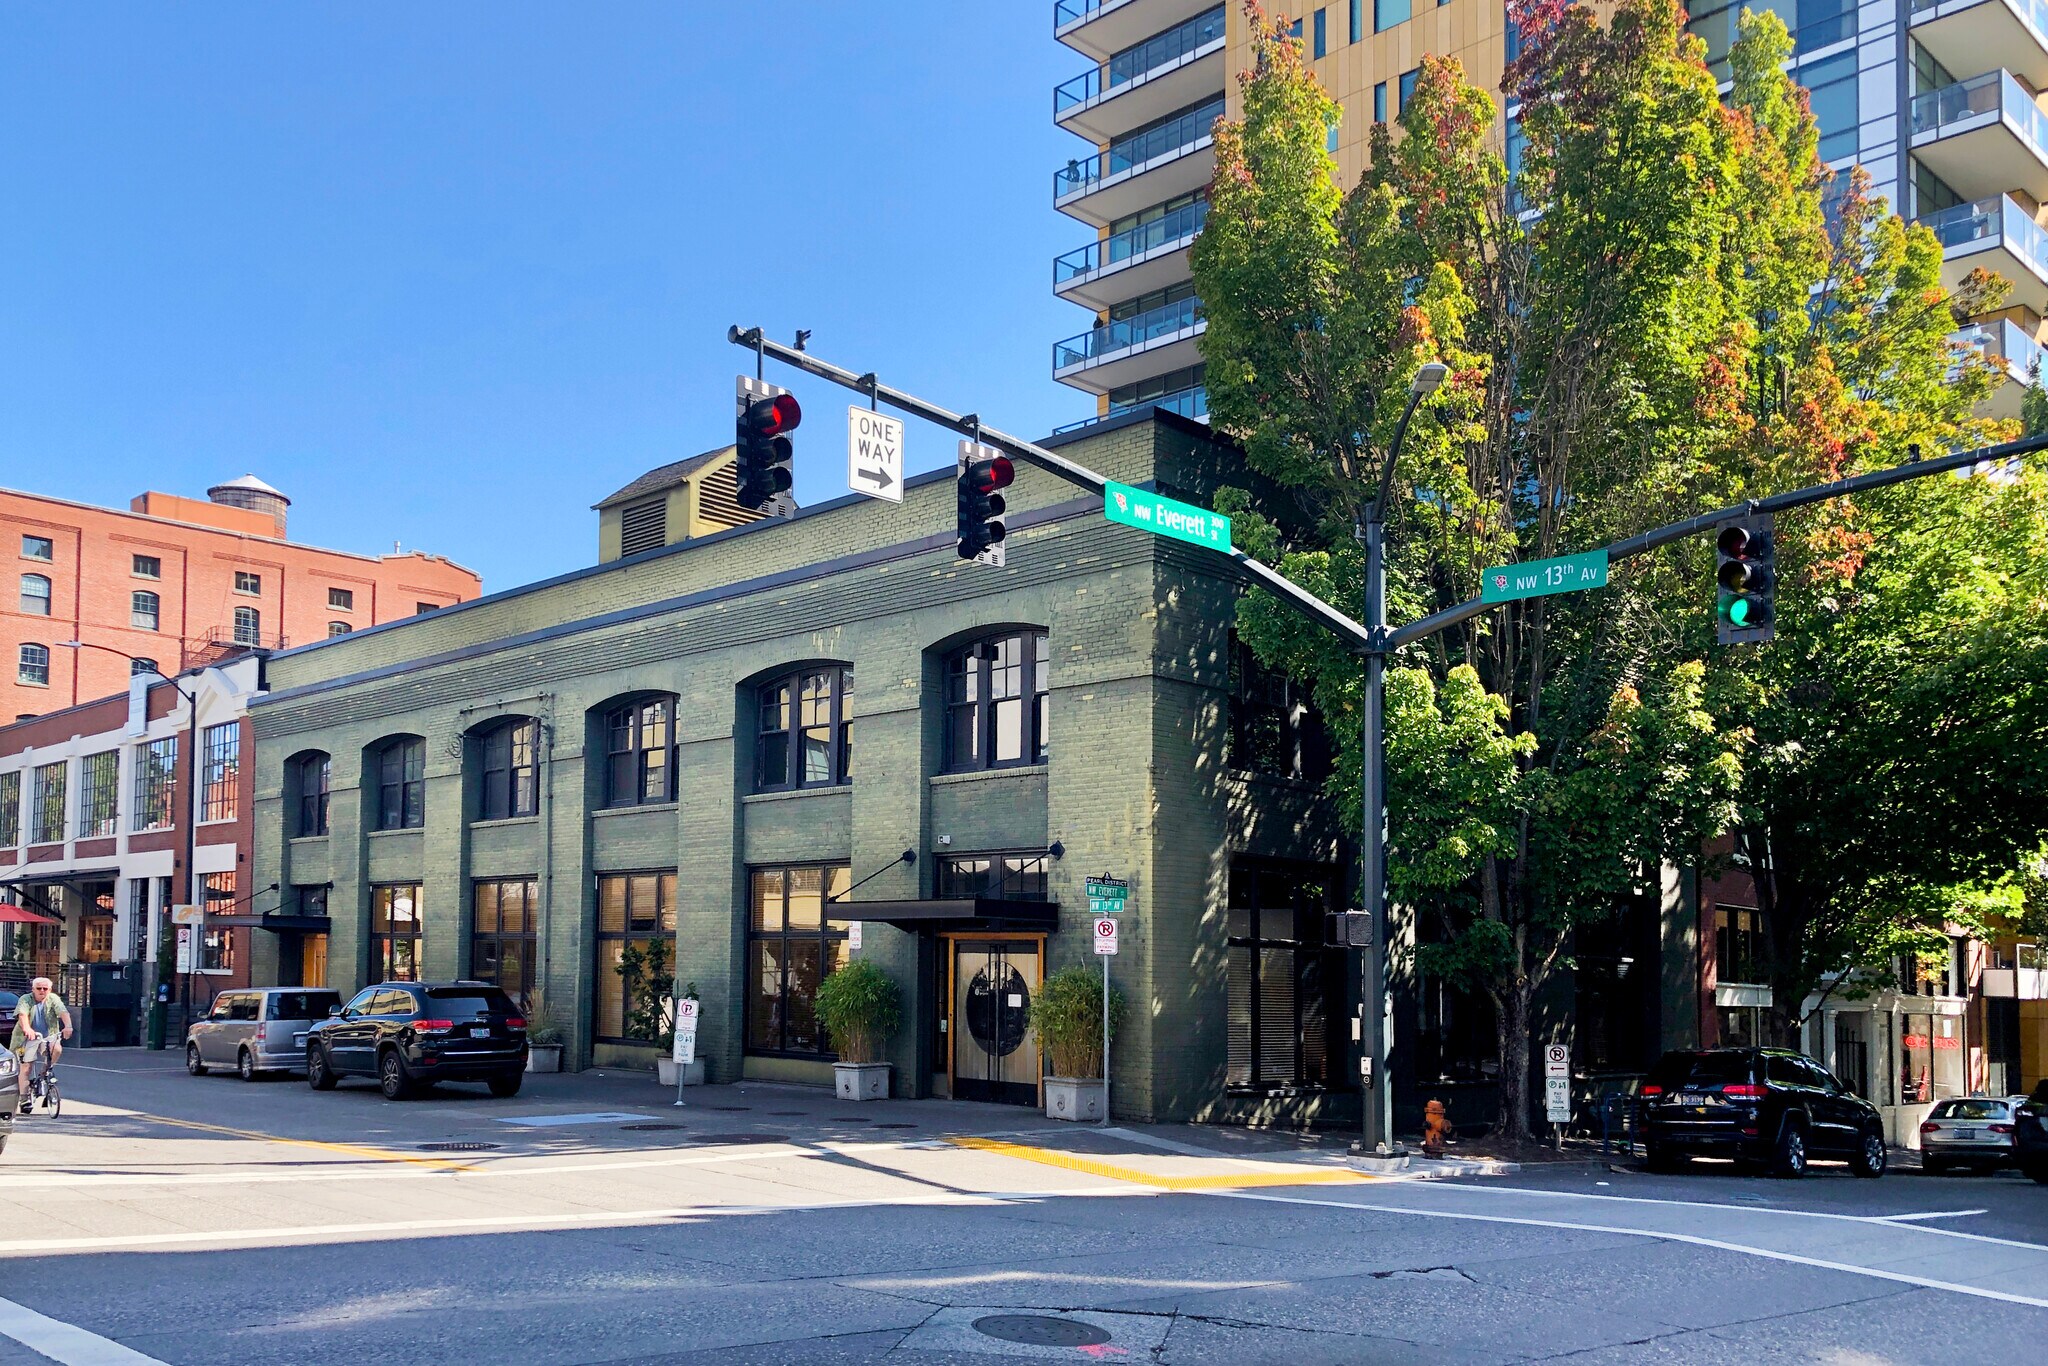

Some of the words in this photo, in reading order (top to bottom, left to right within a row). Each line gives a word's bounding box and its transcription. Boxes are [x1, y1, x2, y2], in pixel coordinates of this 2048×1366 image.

[860, 417, 894, 443] ONE
[858, 437, 895, 464] WAY
[1134, 504, 1151, 521] NW
[1156, 504, 1206, 538] Everett
[1516, 575, 1538, 590] NW
[1545, 563, 1574, 586] 13th
[1581, 567, 1598, 581] Av
[1088, 885, 1097, 895] NW
[1098, 887, 1118, 897] EVERETT
[1104, 879, 1128, 887] DISTRICT
[1091, 902, 1100, 910] NW
